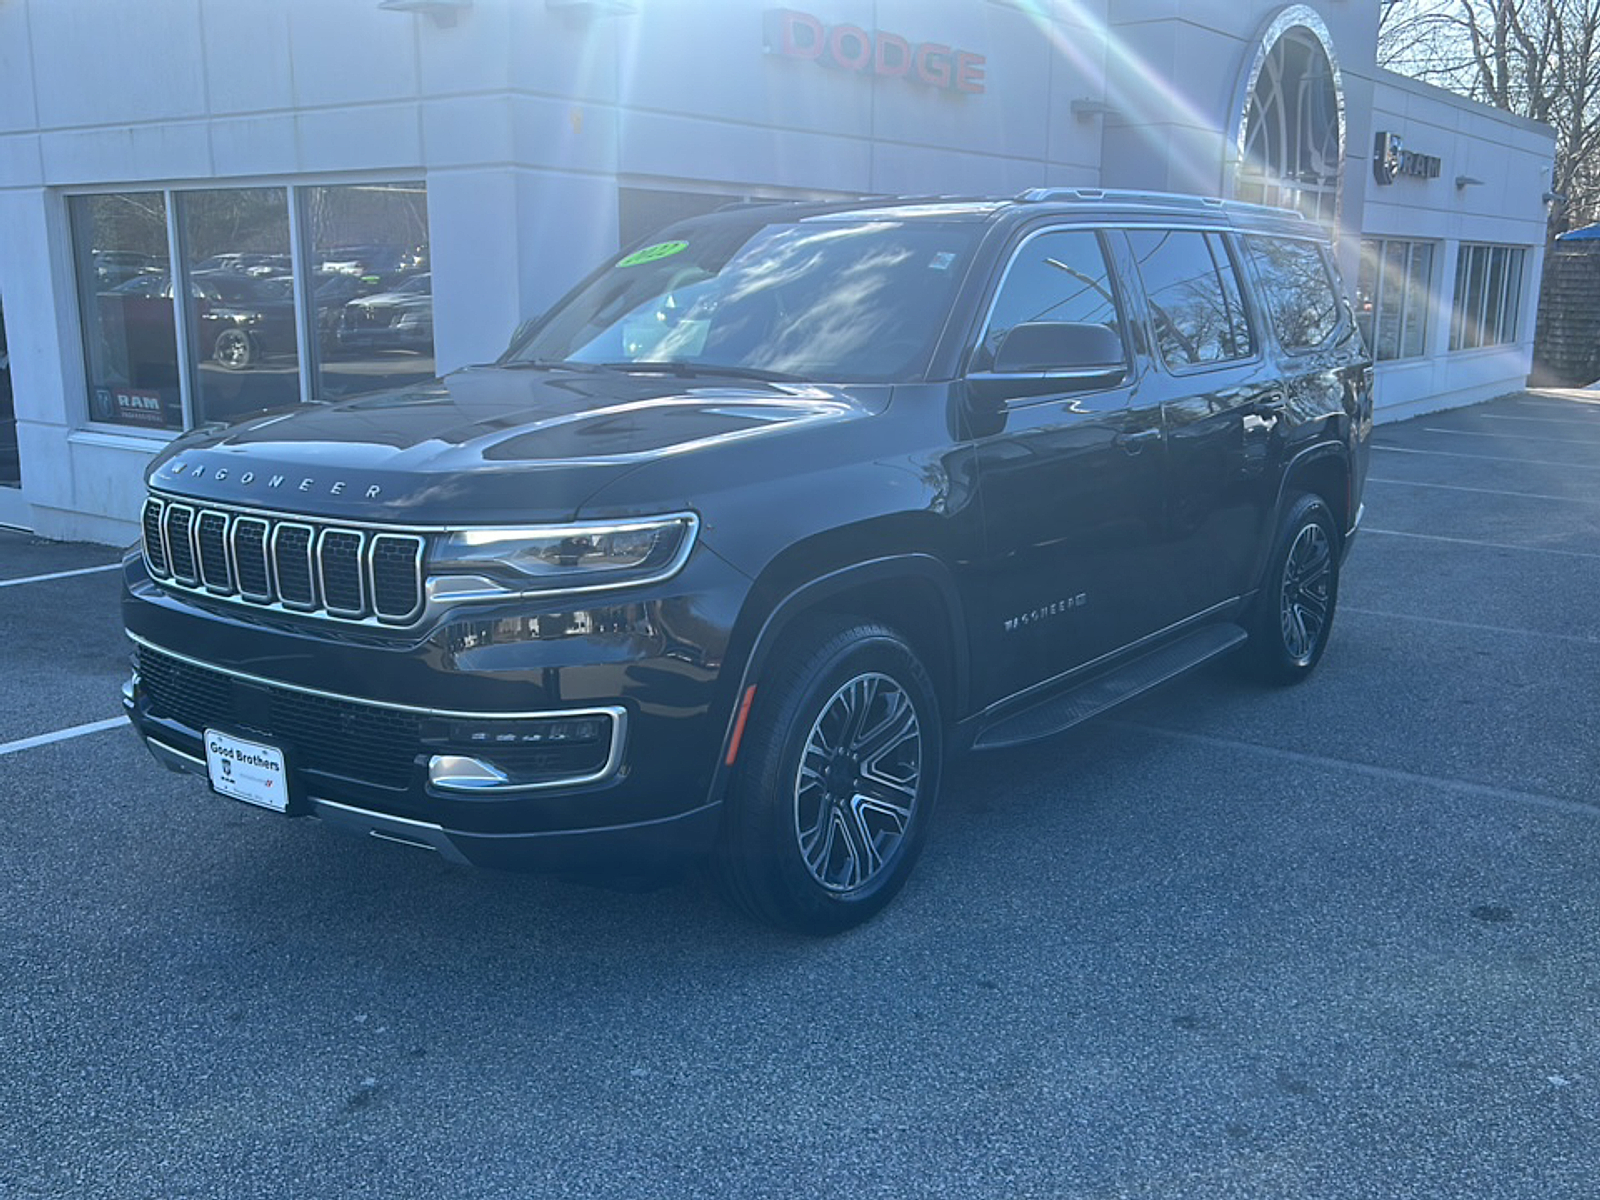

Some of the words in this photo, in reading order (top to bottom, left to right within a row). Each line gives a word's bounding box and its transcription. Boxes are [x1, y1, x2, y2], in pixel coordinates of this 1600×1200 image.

[777, 9, 987, 95] DODGE
[1401, 150, 1441, 178] RAM
[117, 394, 160, 410] RAM
[170, 461, 382, 499] WAGONEER
[210, 741, 234, 759] Good
[235, 749, 280, 772] Brothers
